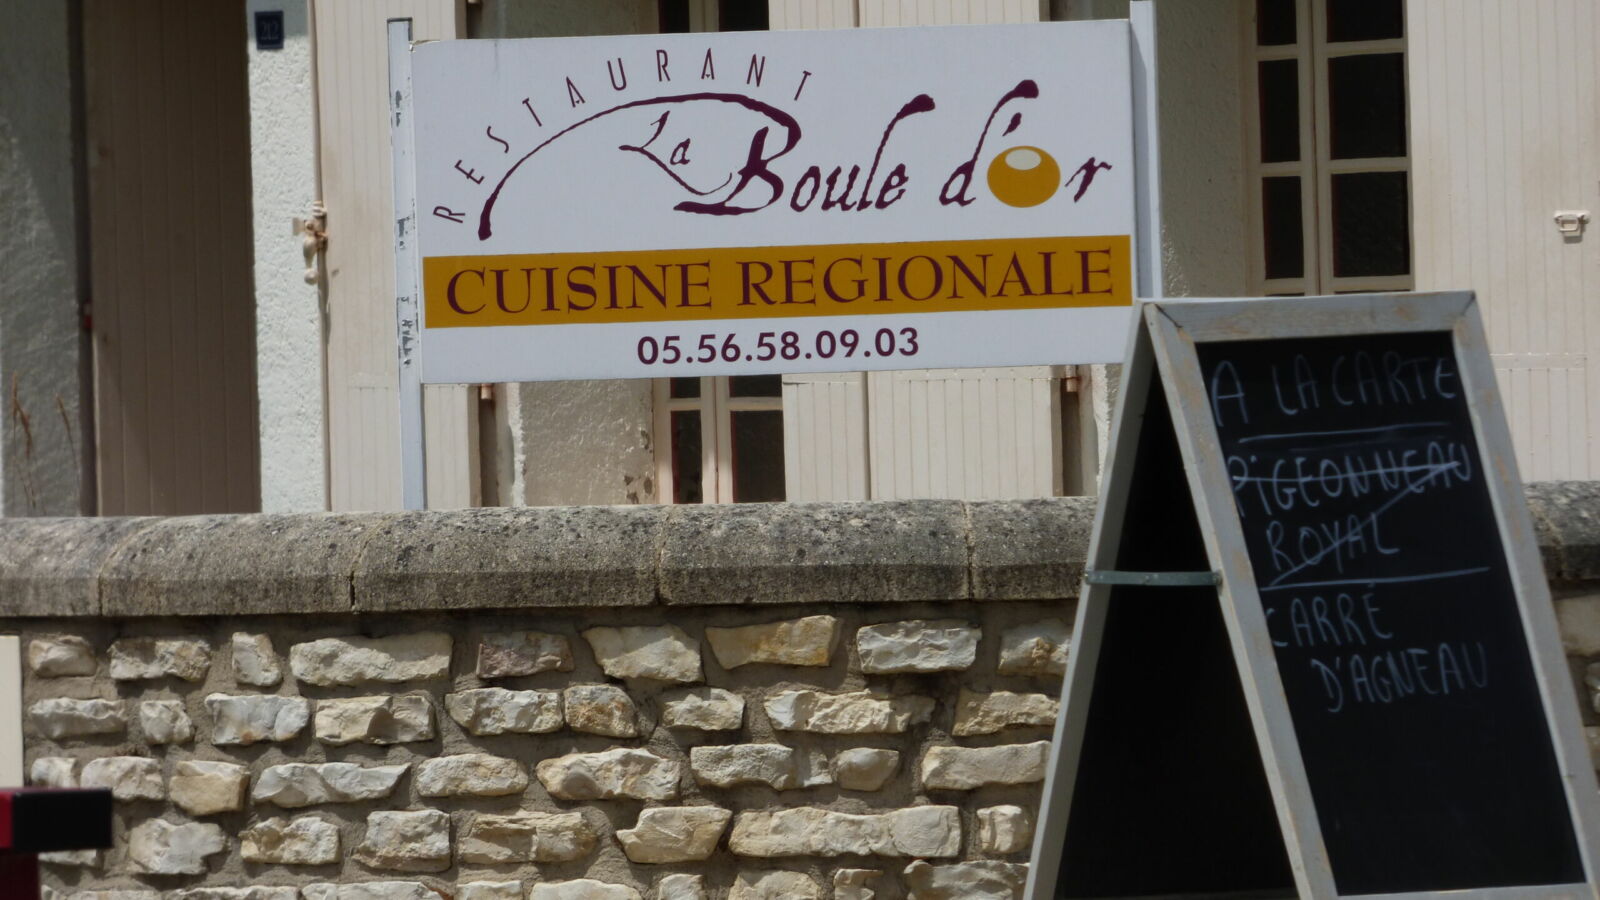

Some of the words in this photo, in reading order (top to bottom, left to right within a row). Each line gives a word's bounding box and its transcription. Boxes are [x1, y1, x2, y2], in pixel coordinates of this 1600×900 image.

[433, 48, 811, 223] RESTAURANT
[618, 111, 732, 195] La
[673, 93, 936, 216] Boule
[446, 260, 712, 314] CUISINE
[736, 245, 1113, 308] REGIONALE
[637, 327, 919, 365] 05.56.58.09.03
[1211, 360, 1249, 426] A
[1272, 354, 1319, 415] LA
[1332, 351, 1457, 406] CARTE
[1266, 512, 1400, 573] ROYAL
[1311, 641, 1488, 713] D'AGNEAU
